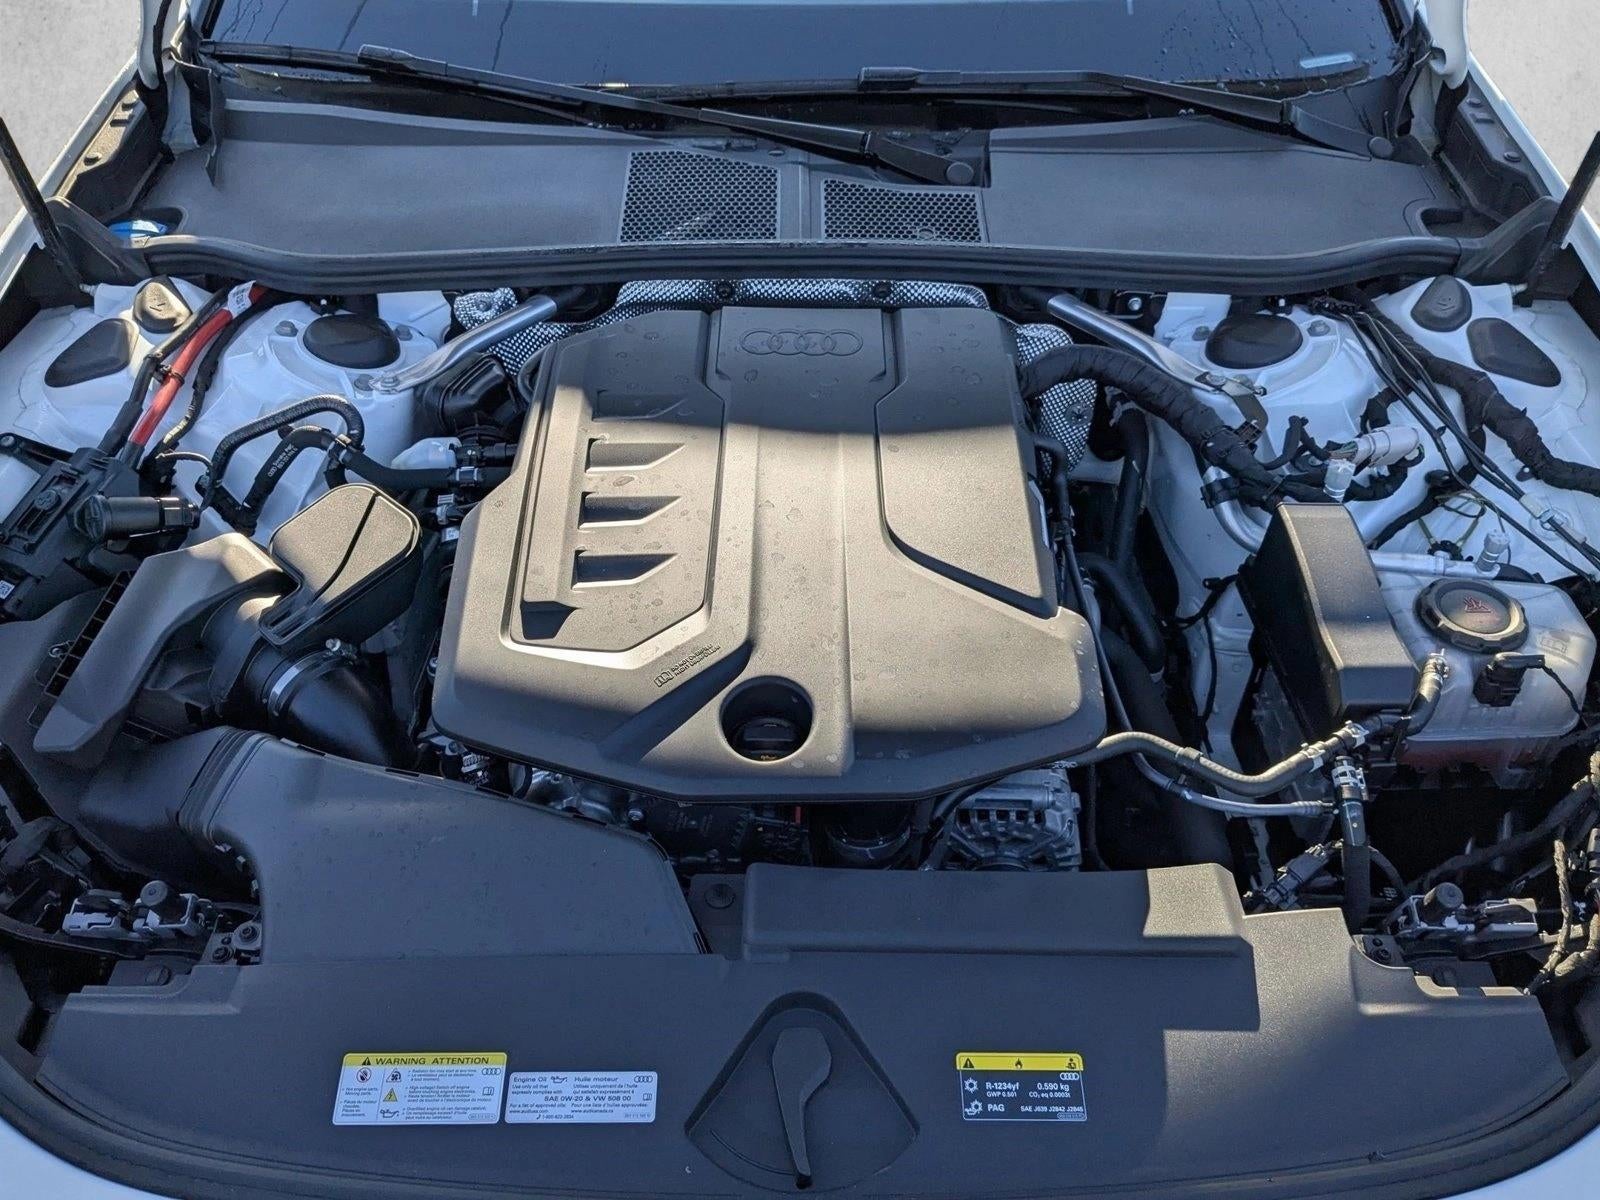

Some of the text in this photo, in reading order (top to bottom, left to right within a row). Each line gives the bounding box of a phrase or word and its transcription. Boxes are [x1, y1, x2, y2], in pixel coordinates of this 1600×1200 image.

[375, 1057, 426, 1065] WARNING
[985, 1082, 1019, 1091] R-1234yf
[1037, 1082, 1070, 1092] 0.590 kg
[987, 1103, 1005, 1111] PAG
